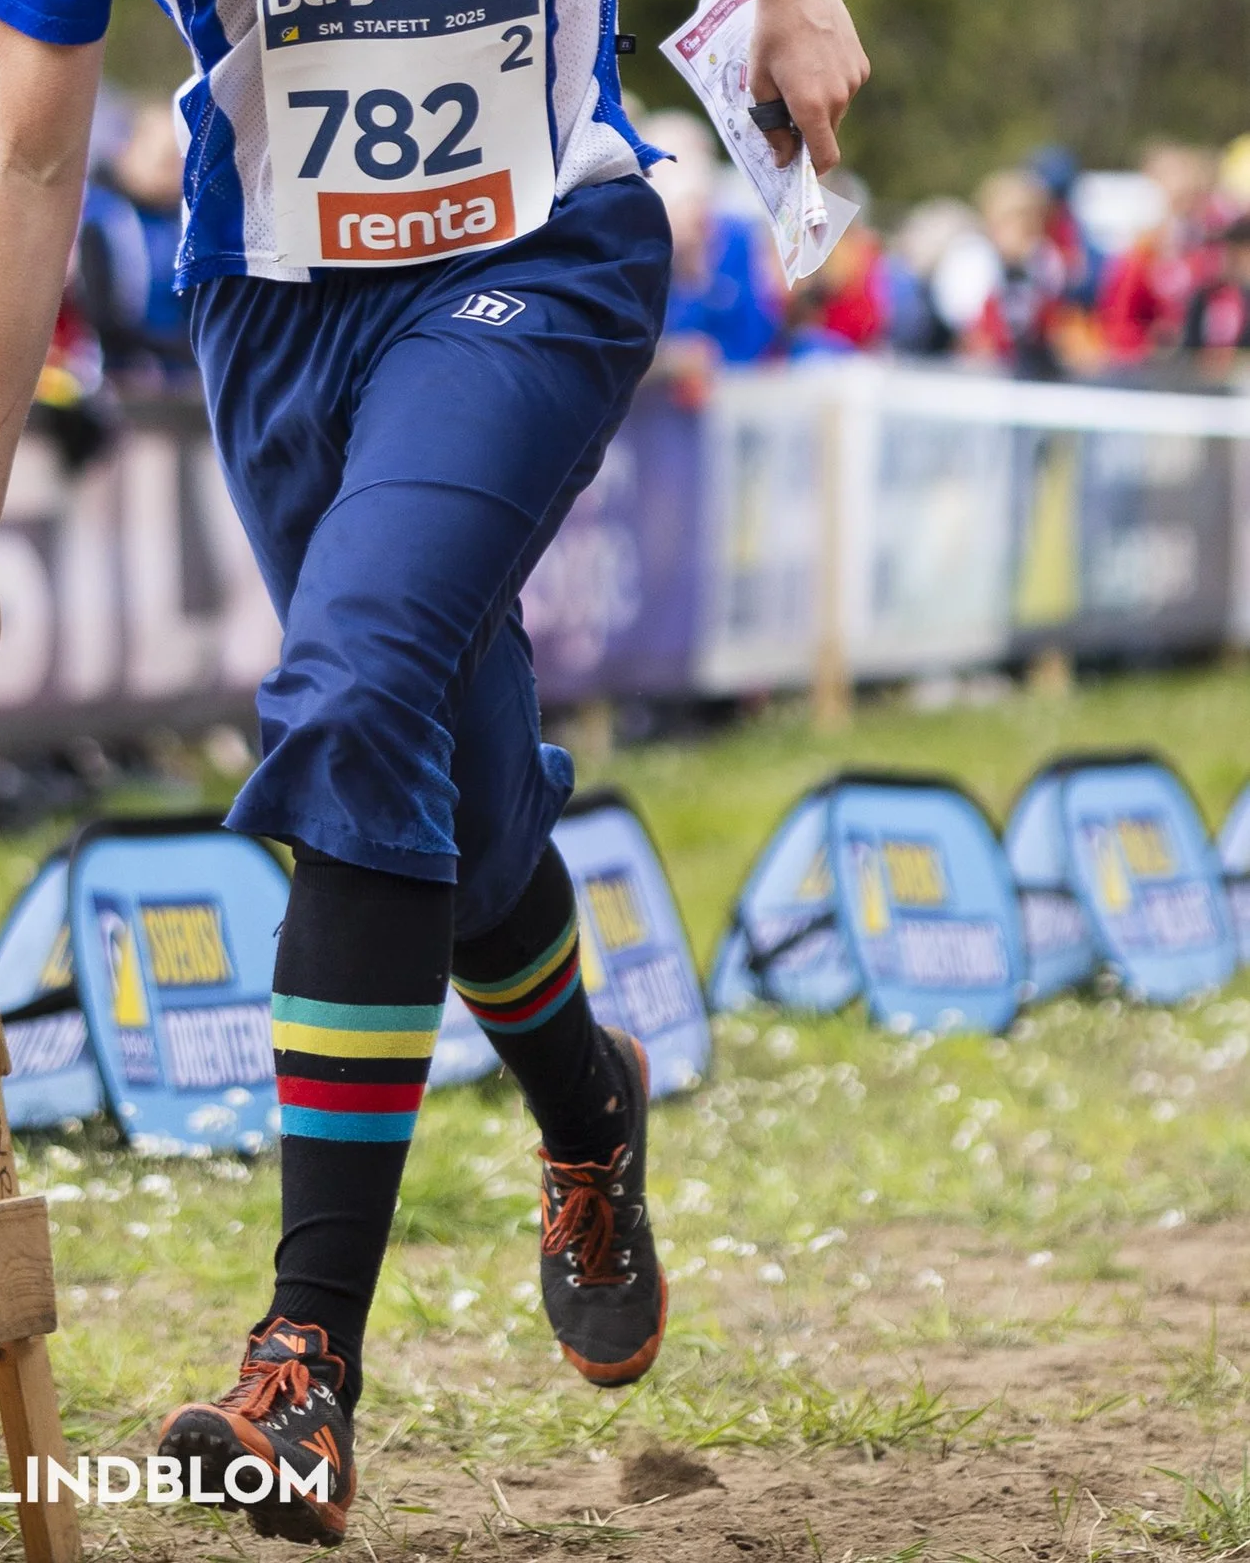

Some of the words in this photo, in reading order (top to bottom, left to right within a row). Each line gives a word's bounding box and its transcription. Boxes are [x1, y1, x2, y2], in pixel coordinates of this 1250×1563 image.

[318, 21, 344, 36] SM
[353, 18, 431, 35] STAFETT
[445, 8, 487, 29] 2025
[500, 23, 534, 73] 2
[287, 81, 483, 181] 782
[337, 195, 497, 251] renta
